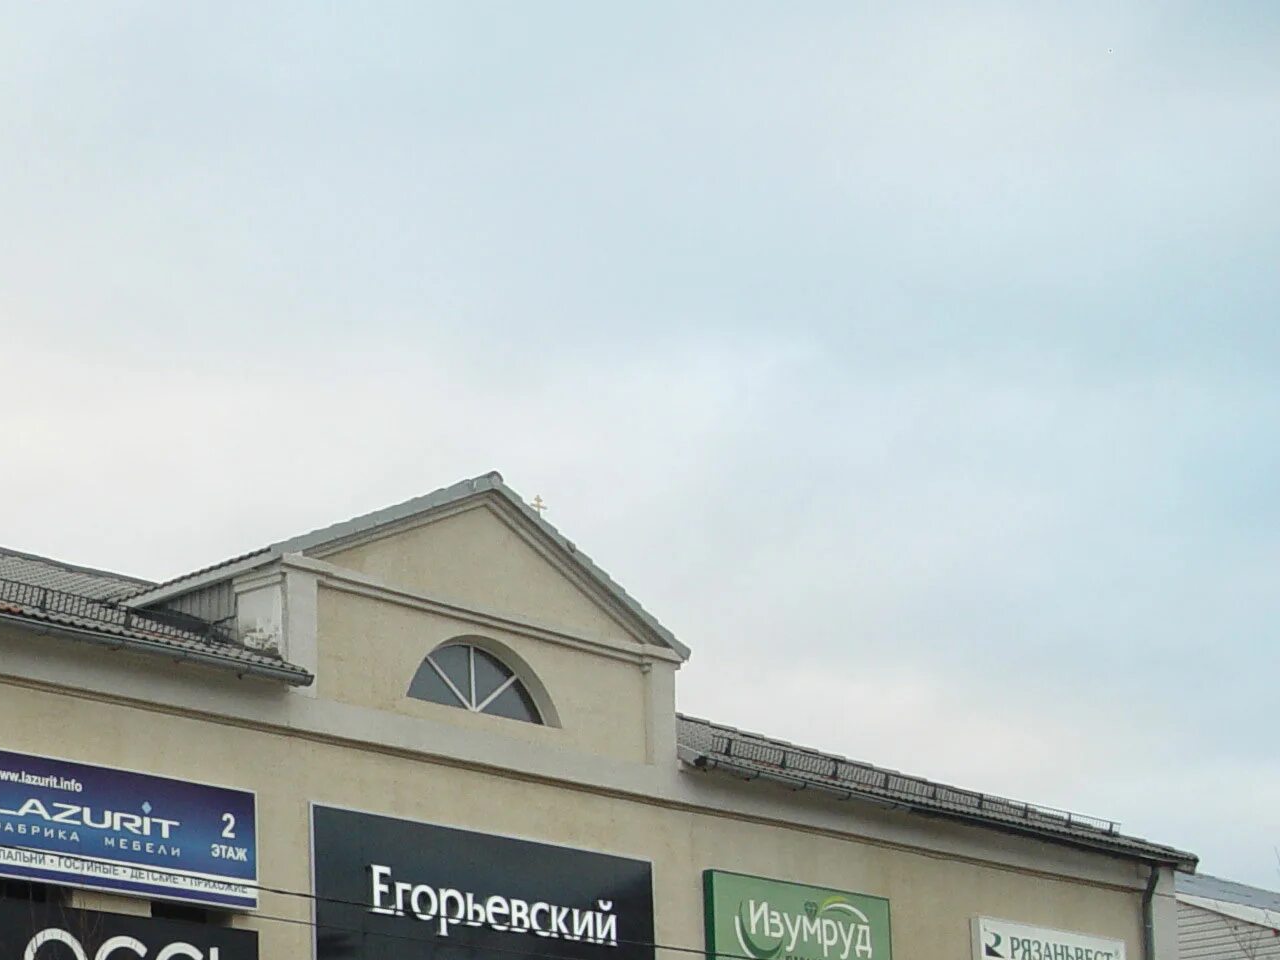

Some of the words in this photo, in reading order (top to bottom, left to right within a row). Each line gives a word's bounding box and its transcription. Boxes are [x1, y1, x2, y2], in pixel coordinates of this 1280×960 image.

[221, 812, 237, 839] 2
[104, 836, 181, 857] МЕБЕЛИ
[210, 843, 248, 862] ЭТАЖ
[130, 867, 179, 885] ДЕТСКИЕ
[369, 863, 618, 947] Егорьевский
